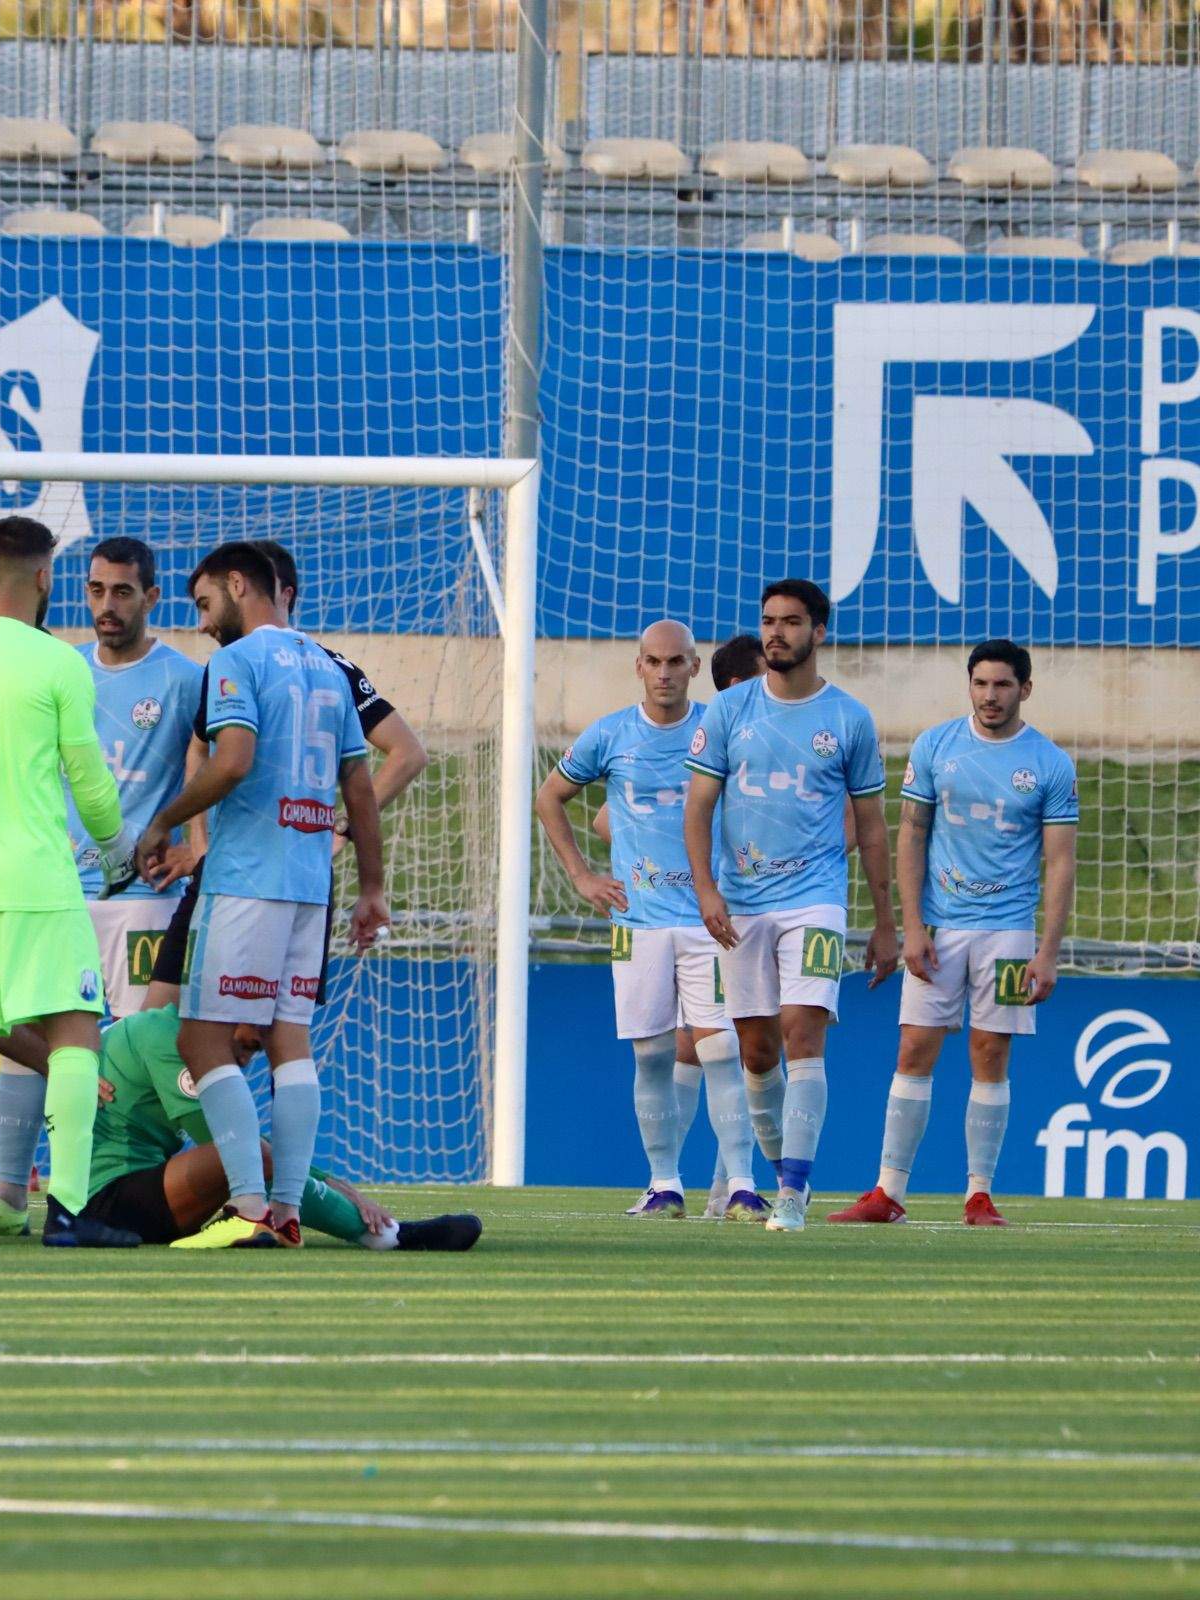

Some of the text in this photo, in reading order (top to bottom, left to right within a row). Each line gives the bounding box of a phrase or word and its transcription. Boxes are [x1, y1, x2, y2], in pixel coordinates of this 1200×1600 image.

[289, 685, 343, 790] 15
[283, 803, 335, 827] CAMPOARAS
[221, 979, 277, 996] CAMPOARAS
[1035, 1103, 1188, 1200] fm
